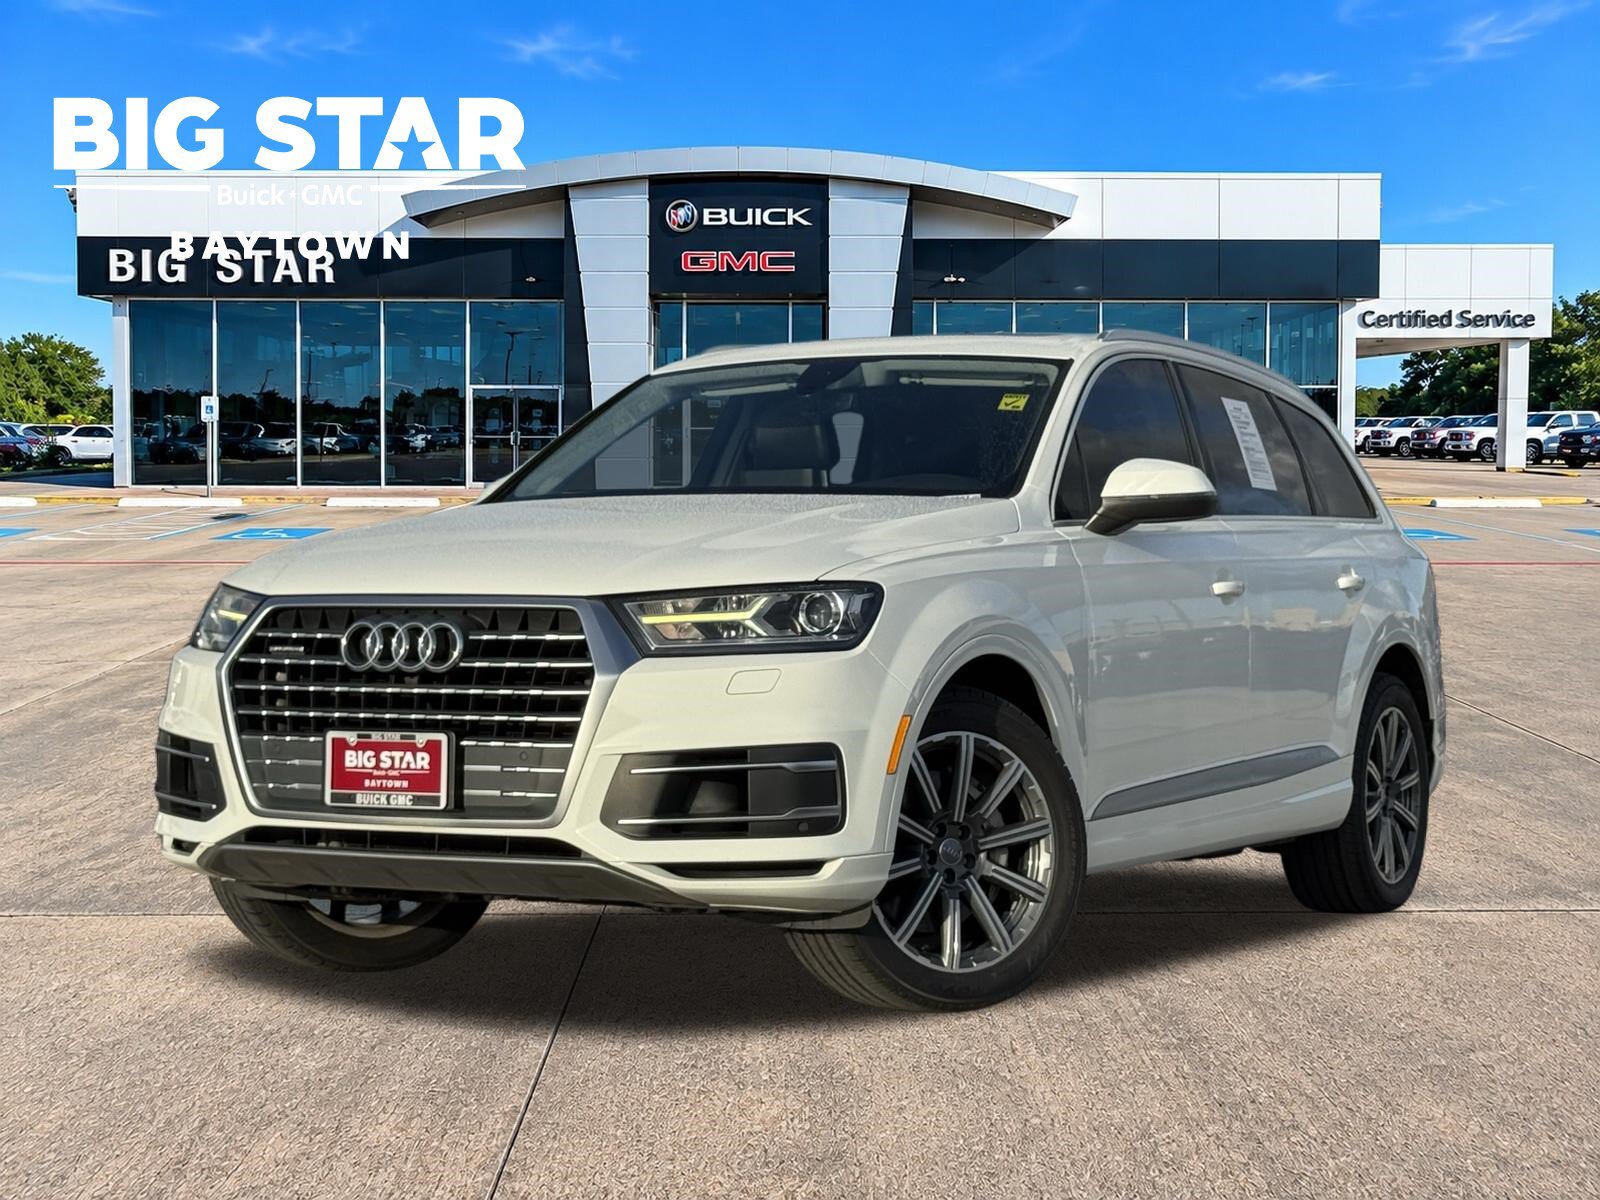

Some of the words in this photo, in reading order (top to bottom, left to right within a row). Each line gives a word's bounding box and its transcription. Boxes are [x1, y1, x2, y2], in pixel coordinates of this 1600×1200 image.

[703, 208, 813, 226] BUICK
[108, 248, 187, 283] BIG
[216, 248, 336, 283] STAR
[681, 251, 796, 272] GMC
[1359, 309, 1453, 329] Certified
[1455, 309, 1536, 329] Service
[344, 749, 377, 769] BIG
[379, 750, 431, 770] STAR
[364, 778, 409, 789] BAYTOWN
[355, 793, 388, 805] BUICK
[389, 794, 414, 806] GMC
